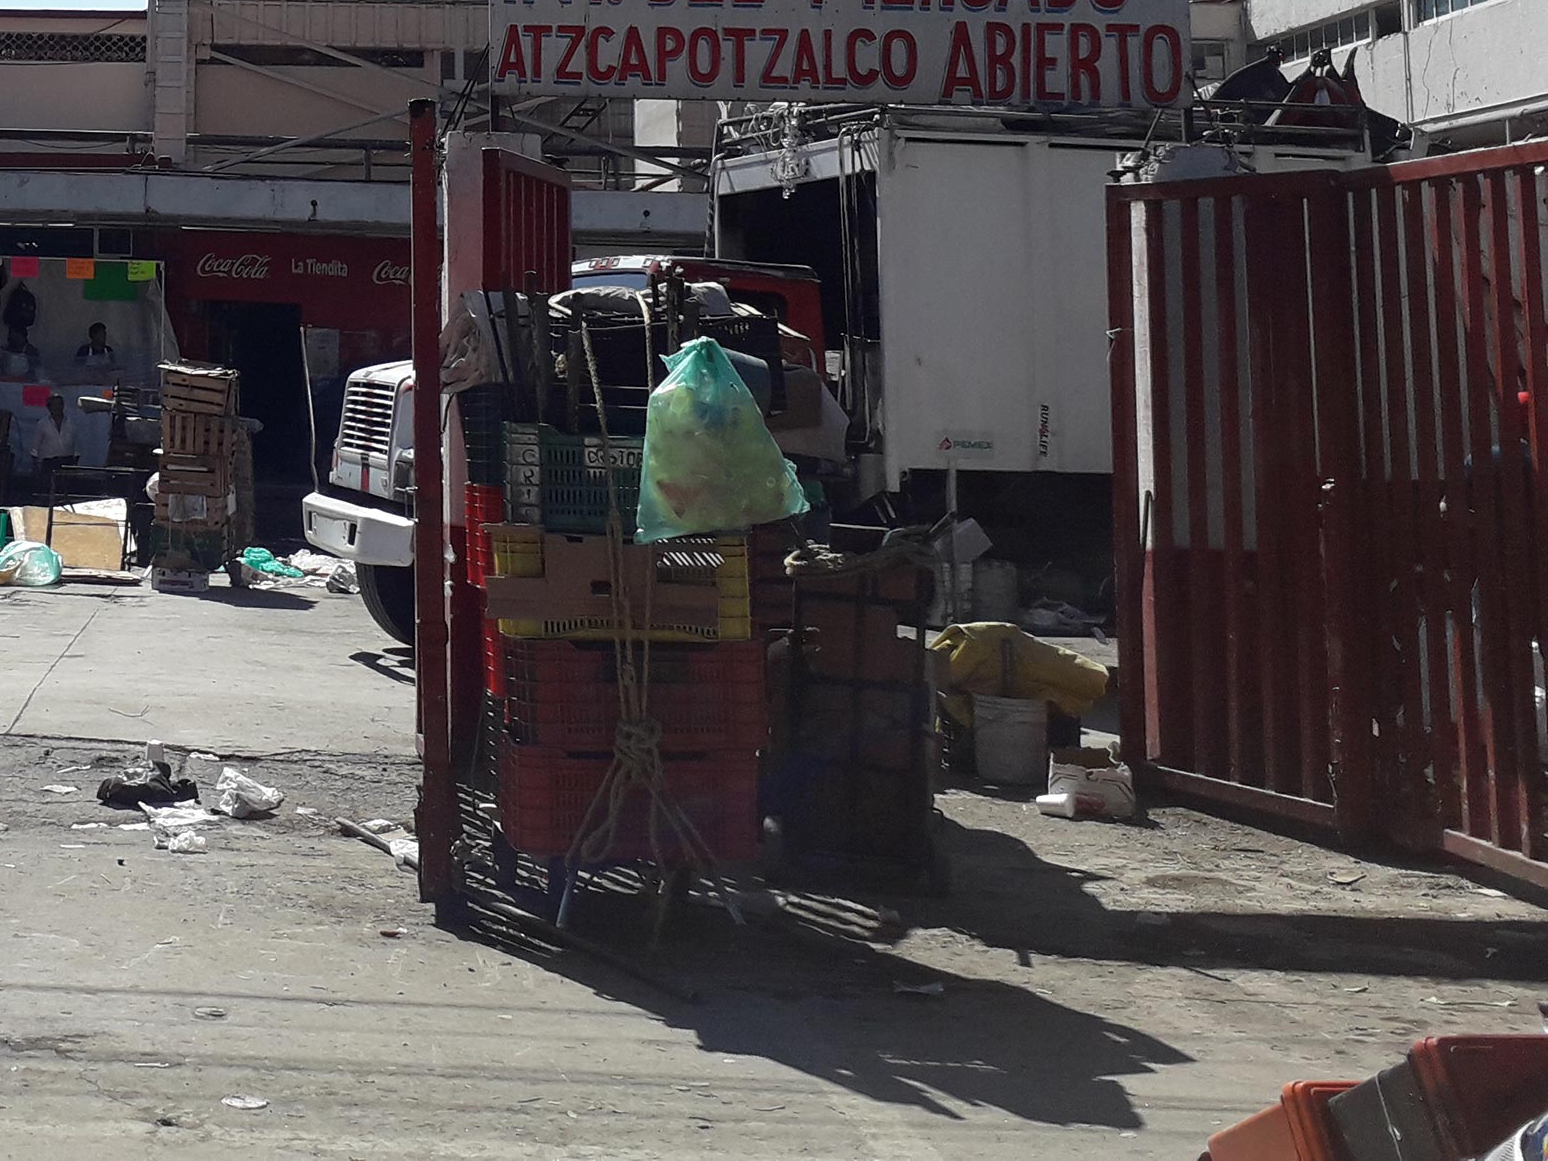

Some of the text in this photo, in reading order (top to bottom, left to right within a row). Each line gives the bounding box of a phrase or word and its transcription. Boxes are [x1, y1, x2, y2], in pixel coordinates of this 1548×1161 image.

[495, 21, 1184, 105] ATZCAPOTZALCO ABIERTO
[291, 258, 349, 278] La Tiendita
